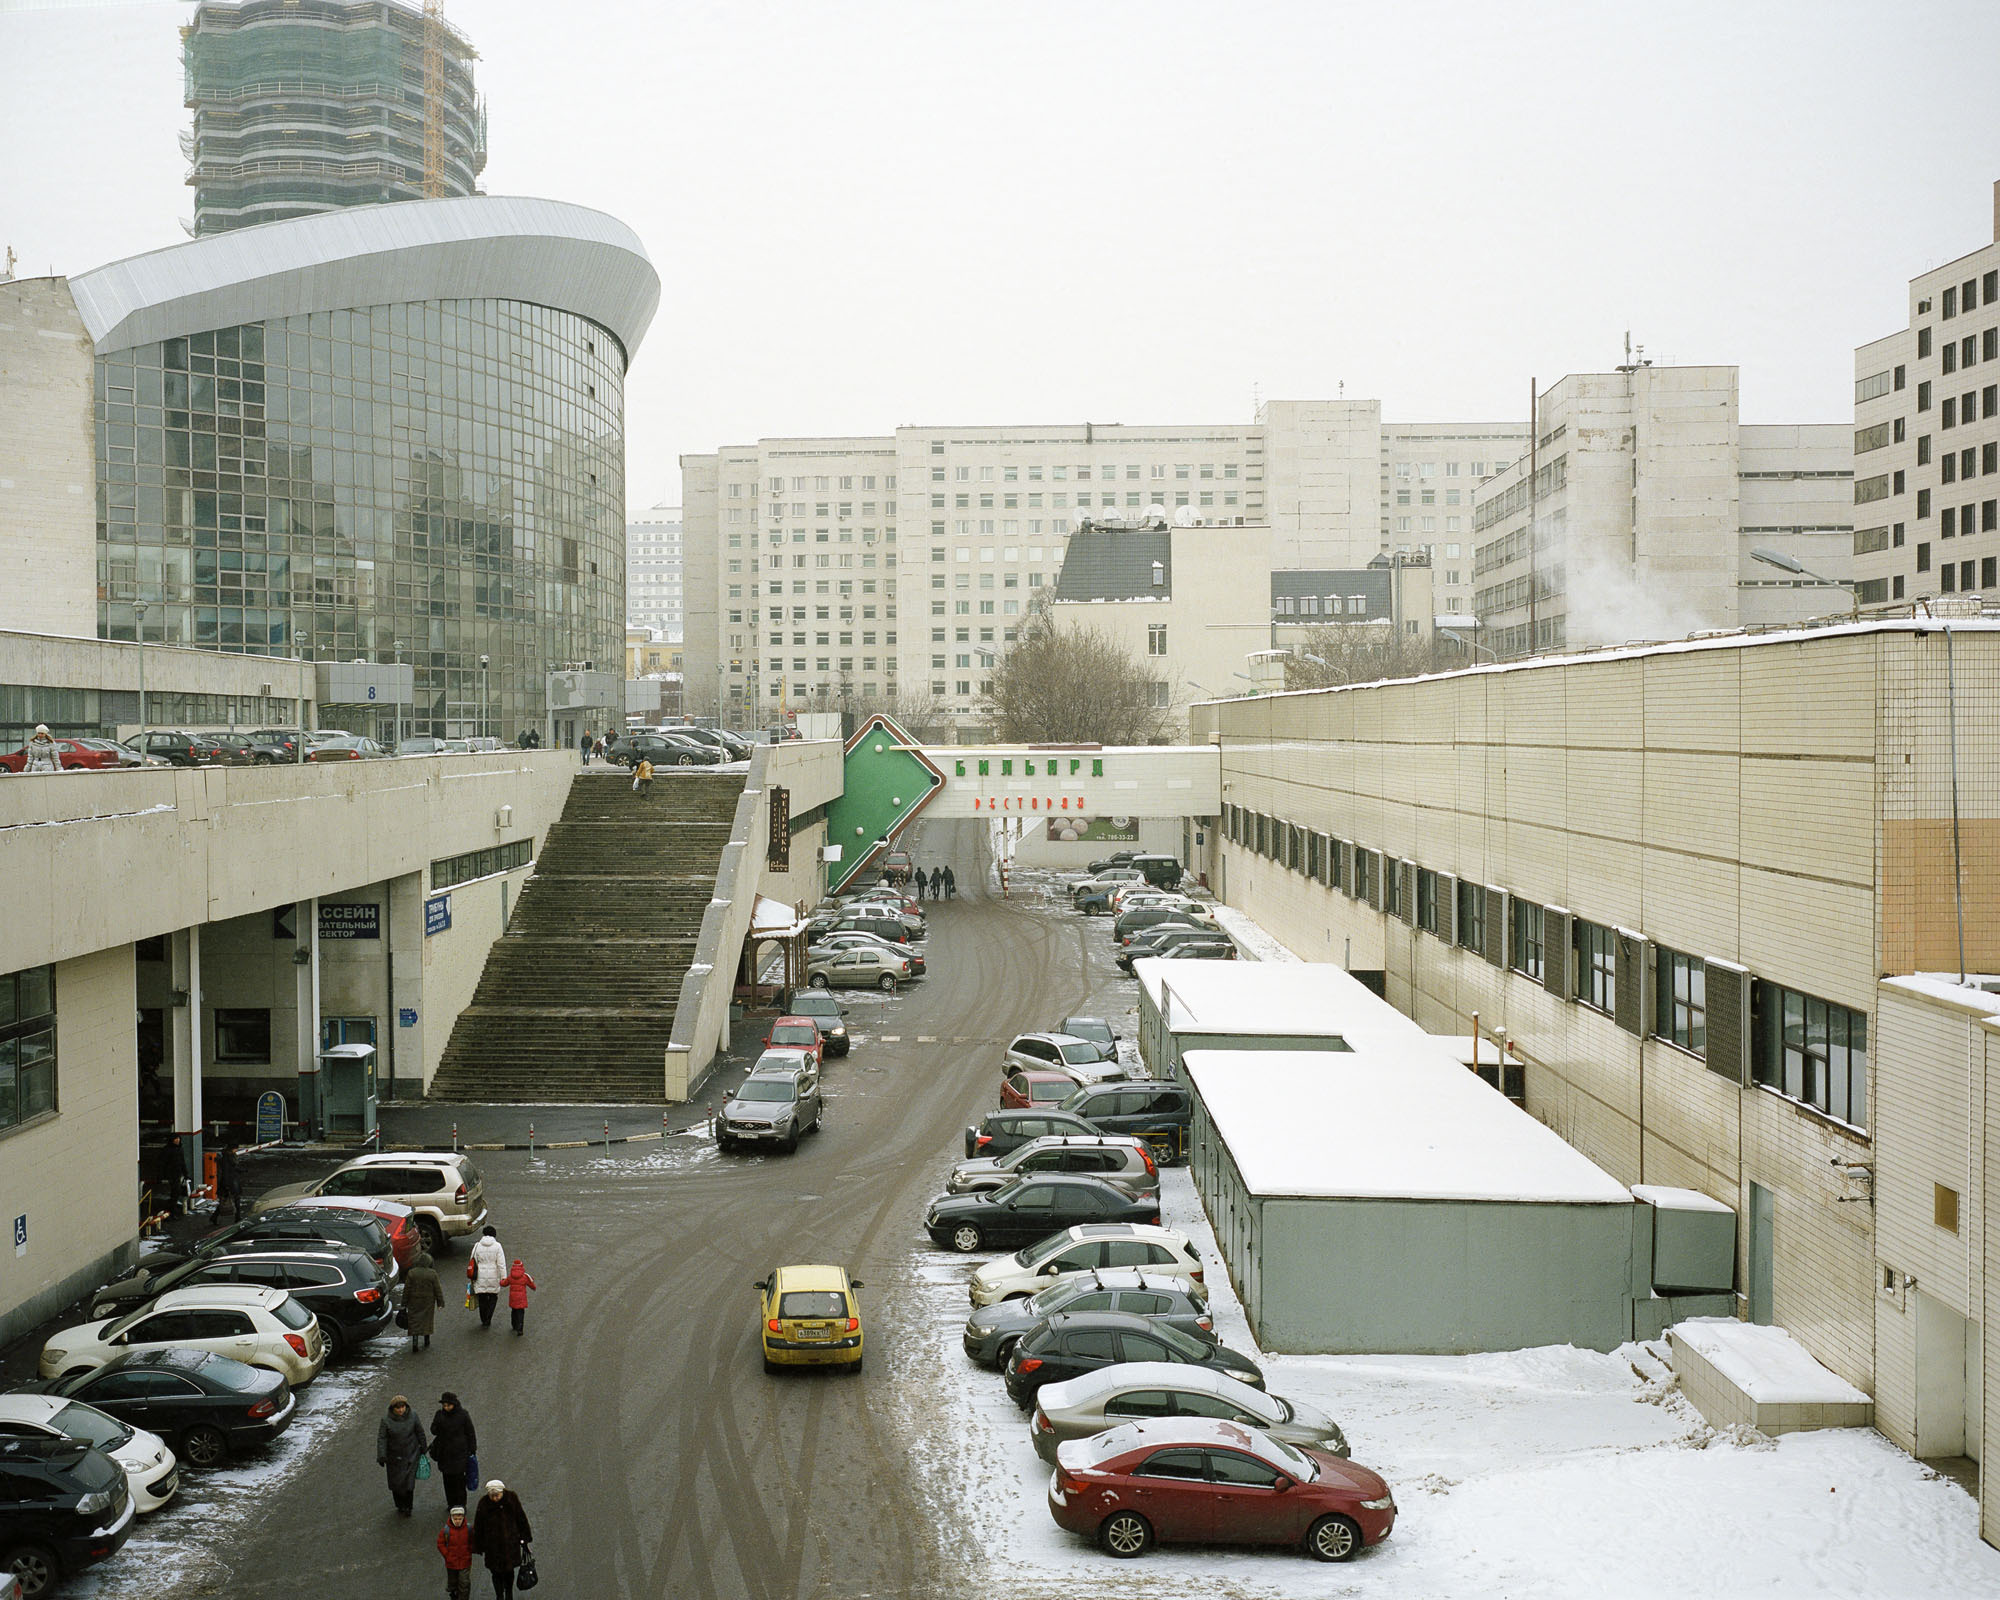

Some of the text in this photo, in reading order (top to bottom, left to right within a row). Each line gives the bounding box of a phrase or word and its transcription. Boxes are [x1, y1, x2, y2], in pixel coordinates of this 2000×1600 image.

[368, 686, 376, 700] 8
[955, 758, 1104, 777] БИЛЬЯРД
[975, 796, 1085, 811] РЕСТОРАН
[318, 905, 376, 919] ССЕЙН
[318, 921, 377, 929] ВАТЕЛЬНЫЙ
[319, 930, 356, 938] СЕКТОР
